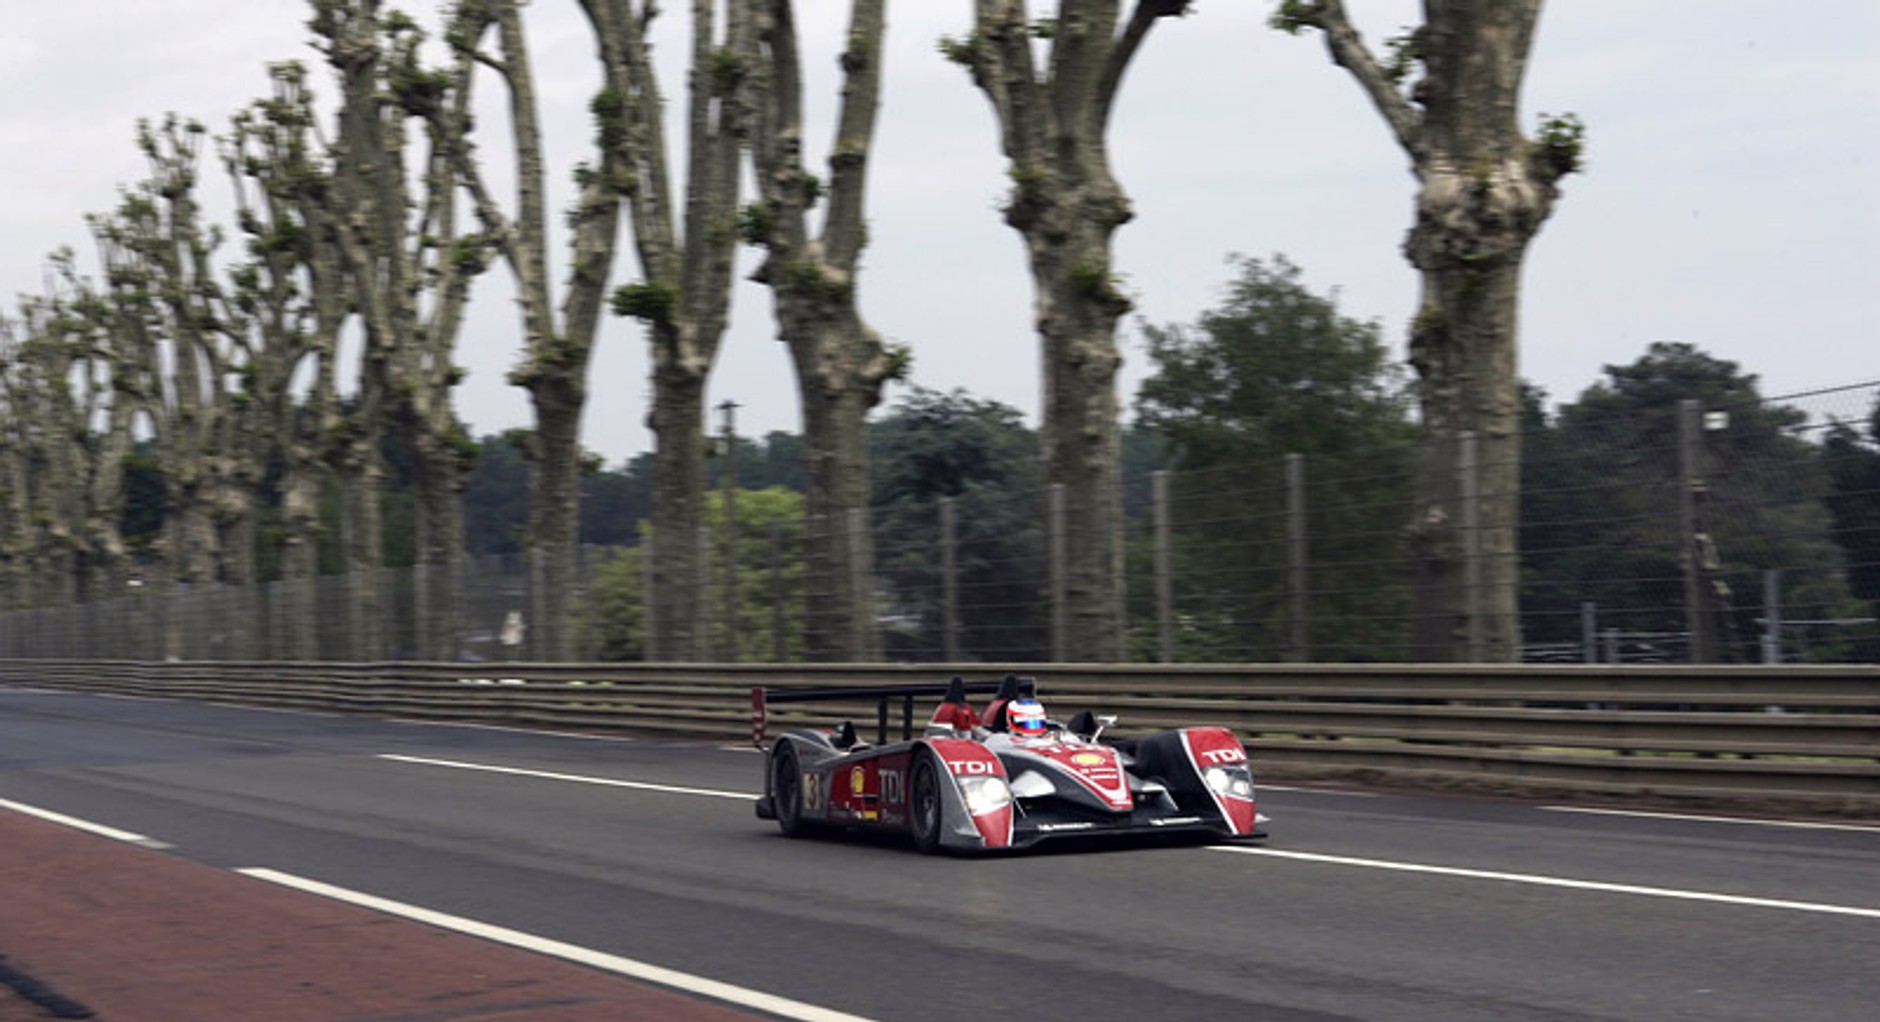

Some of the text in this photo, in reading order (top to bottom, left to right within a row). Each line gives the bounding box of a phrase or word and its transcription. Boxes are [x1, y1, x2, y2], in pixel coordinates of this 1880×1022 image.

[1201, 748, 1247, 763] TDI
[949, 761, 993, 774] TDI
[878, 769, 904, 804] TDI
